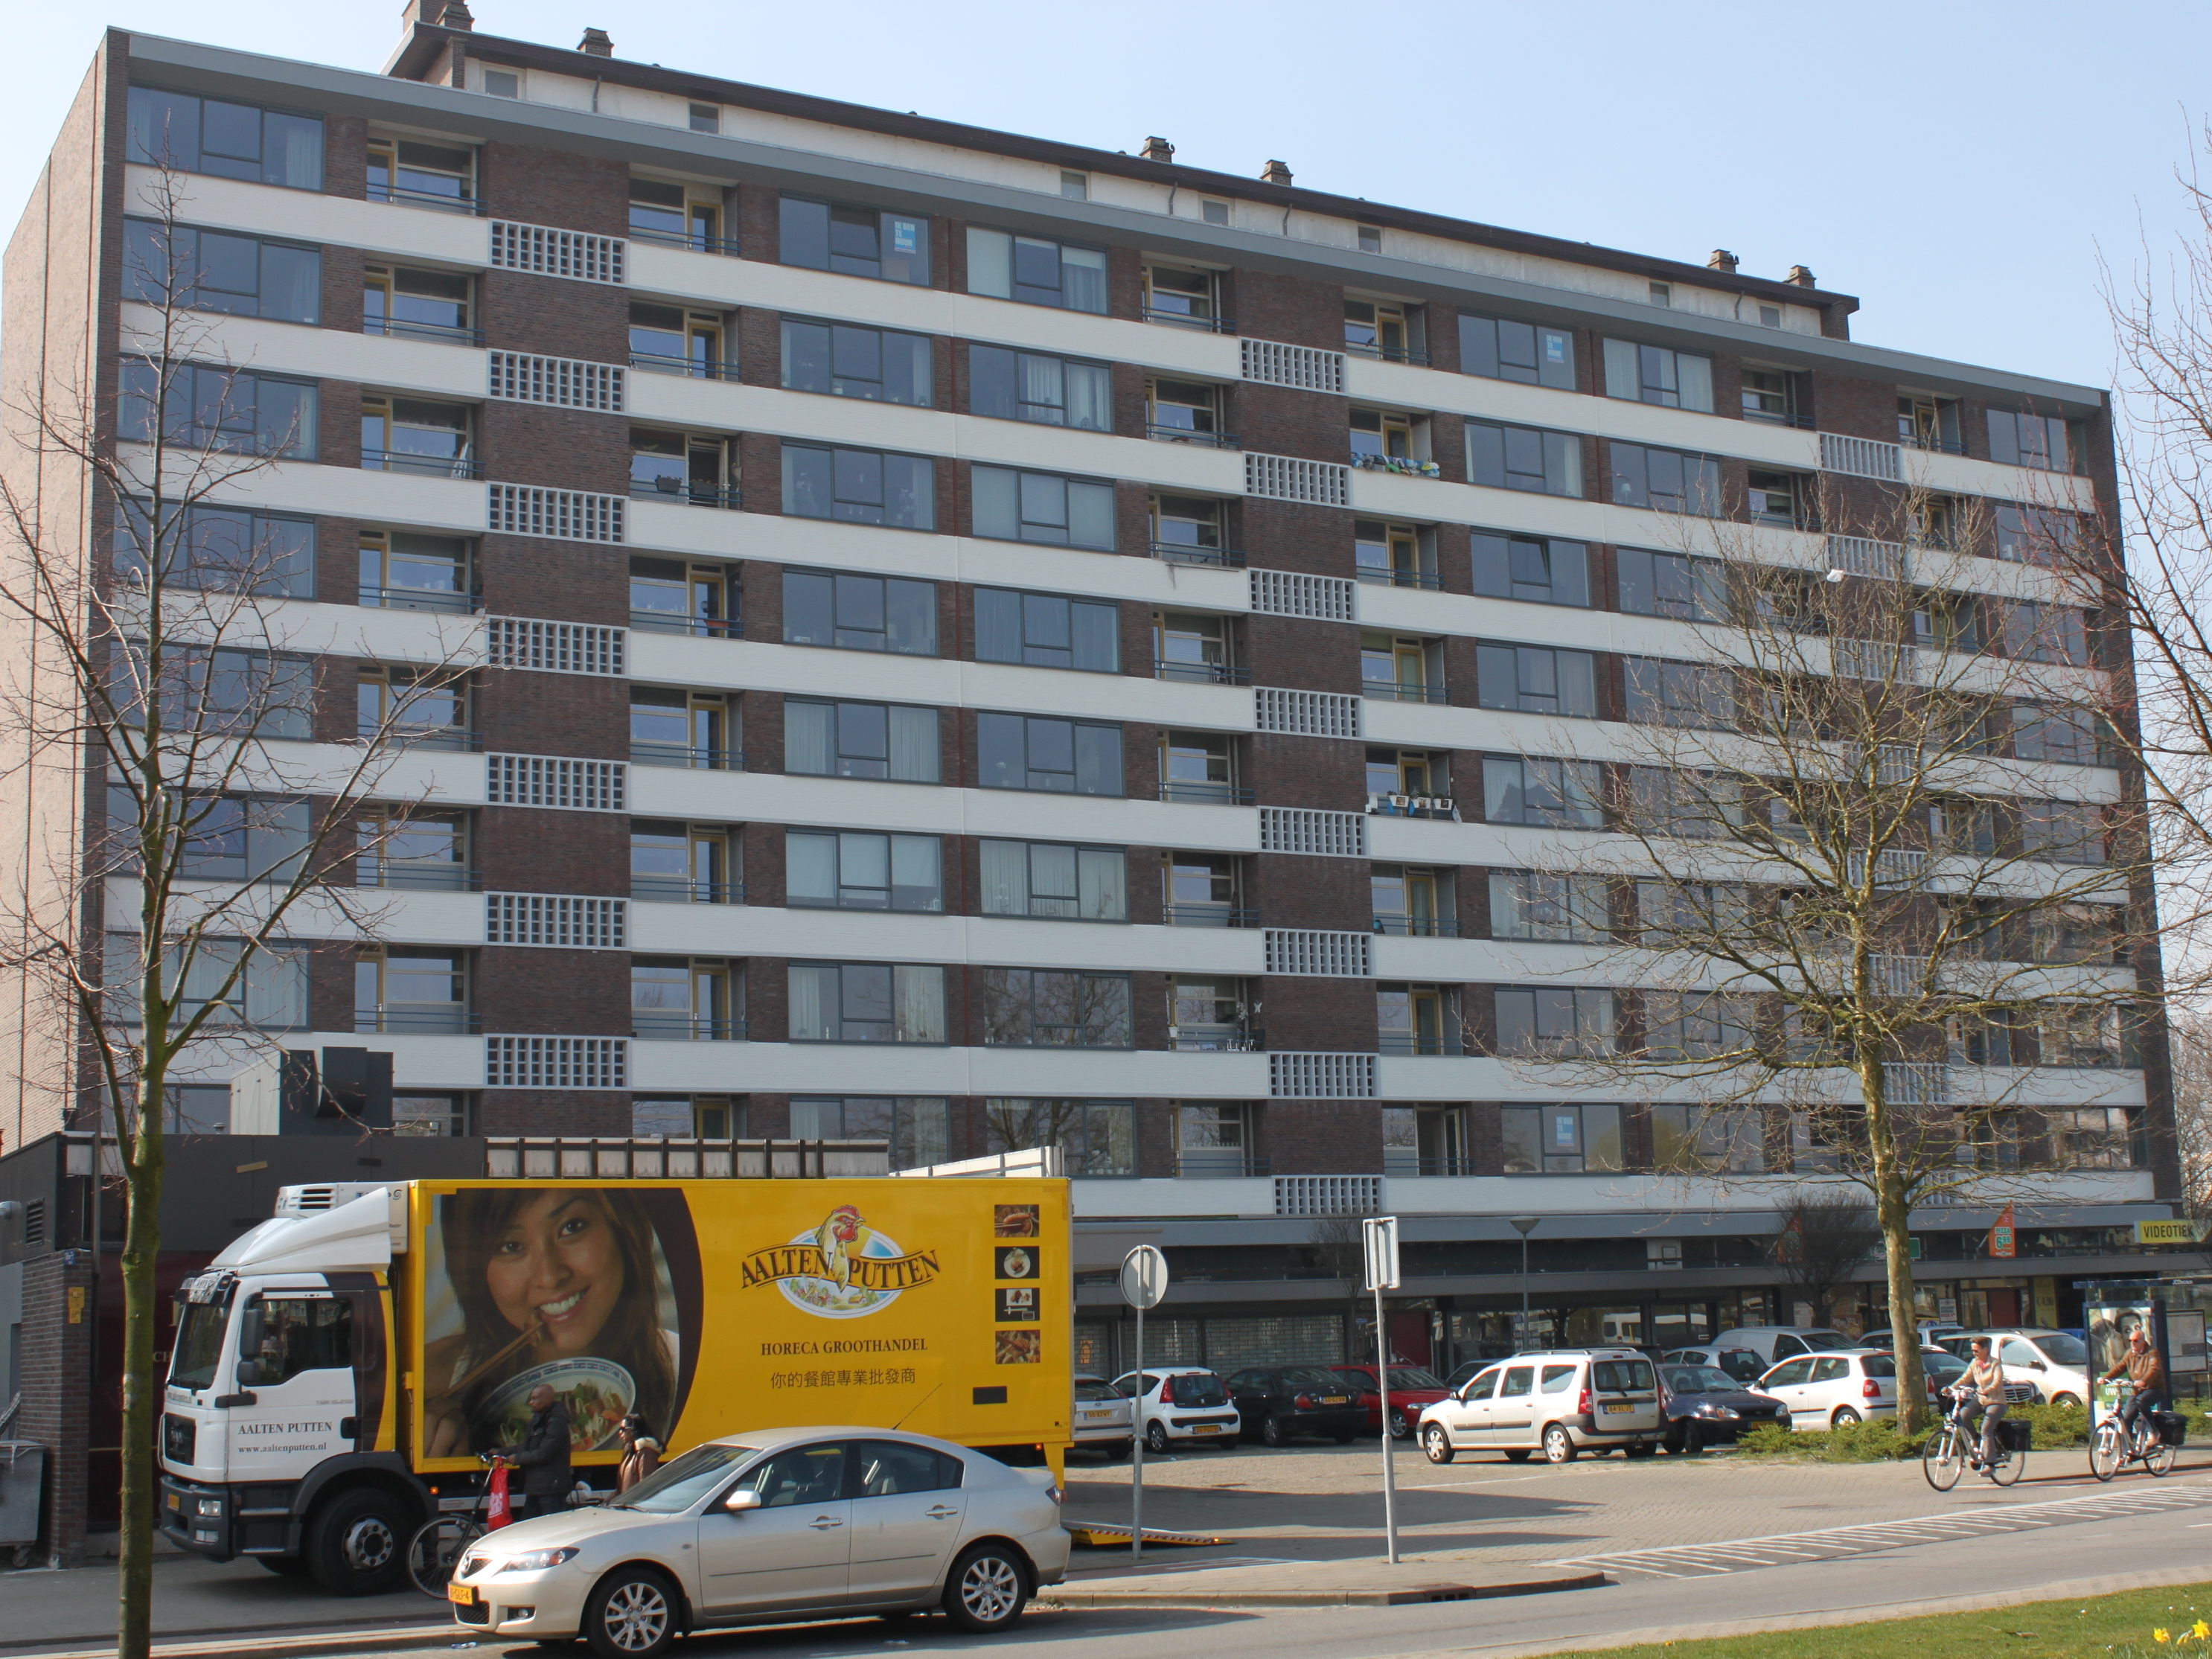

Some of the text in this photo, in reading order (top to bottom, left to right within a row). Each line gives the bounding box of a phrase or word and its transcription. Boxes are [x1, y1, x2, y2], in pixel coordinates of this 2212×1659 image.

[895, 229, 903, 237] TE
[903, 223, 915, 231] BEN
[895, 237, 912, 246] HUUR
[2144, 1225, 2193, 1238] VIDEOTIEK
[742, 1249, 941, 1289] AALTEN PUTTEN
[761, 1338, 928, 1355] HORECA GROOTHANDEL
[770, 1367, 916, 1390] 你的餐館專業批發商
[238, 1422, 333, 1435] AALTEN PUTTEN
[238, 1442, 327, 1454] www.aaltenputten.nl
